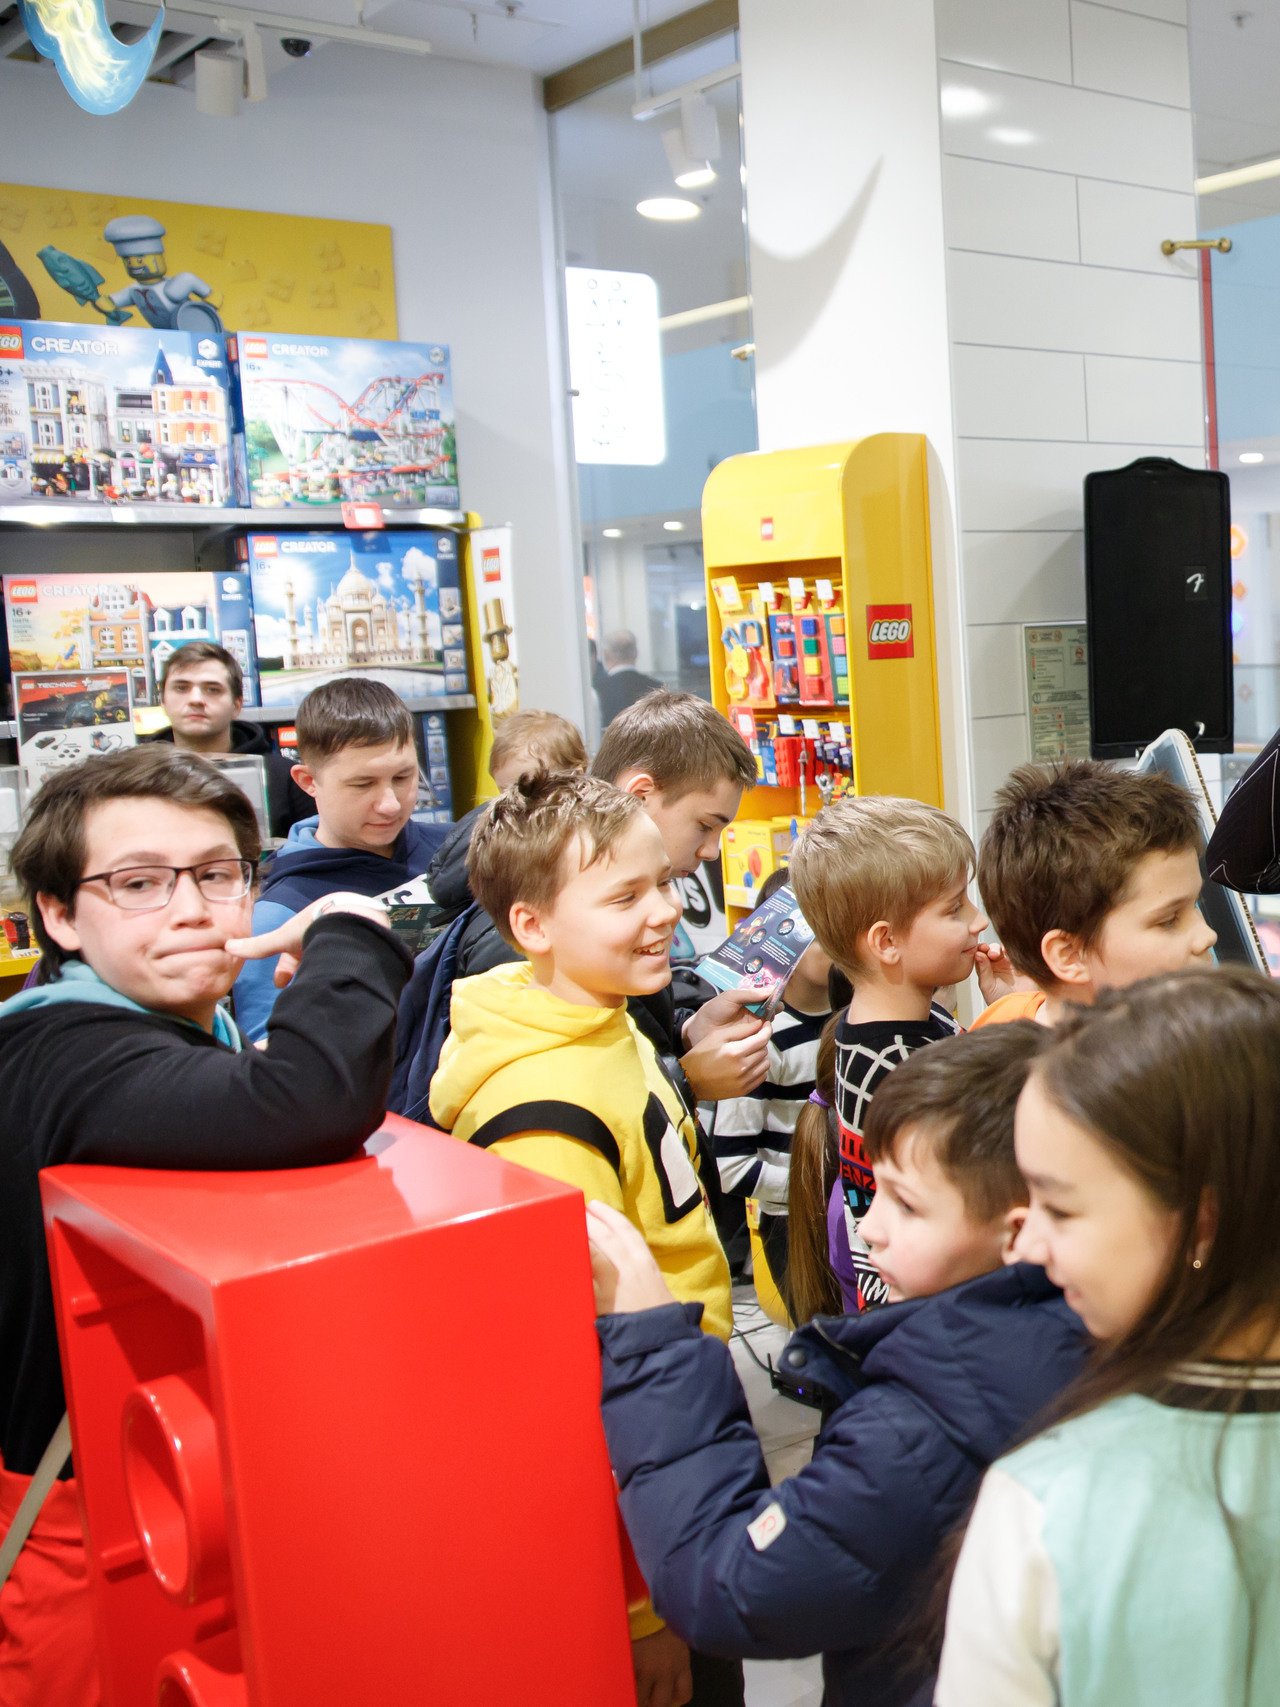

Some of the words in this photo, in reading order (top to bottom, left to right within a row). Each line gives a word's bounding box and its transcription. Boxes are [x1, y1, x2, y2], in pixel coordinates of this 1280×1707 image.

[31, 336, 119, 355] CREATOR
[271, 343, 329, 357] CREATOR
[281, 541, 337, 553] CREATOR
[483, 557, 499, 572] LEGO
[11, 586, 36, 597] LEGO
[43, 585, 110, 597] CREATOR
[12, 608, 32, 617] 16+
[869, 619, 911, 643] LEGO
[36, 681, 79, 689] TECHNIC
